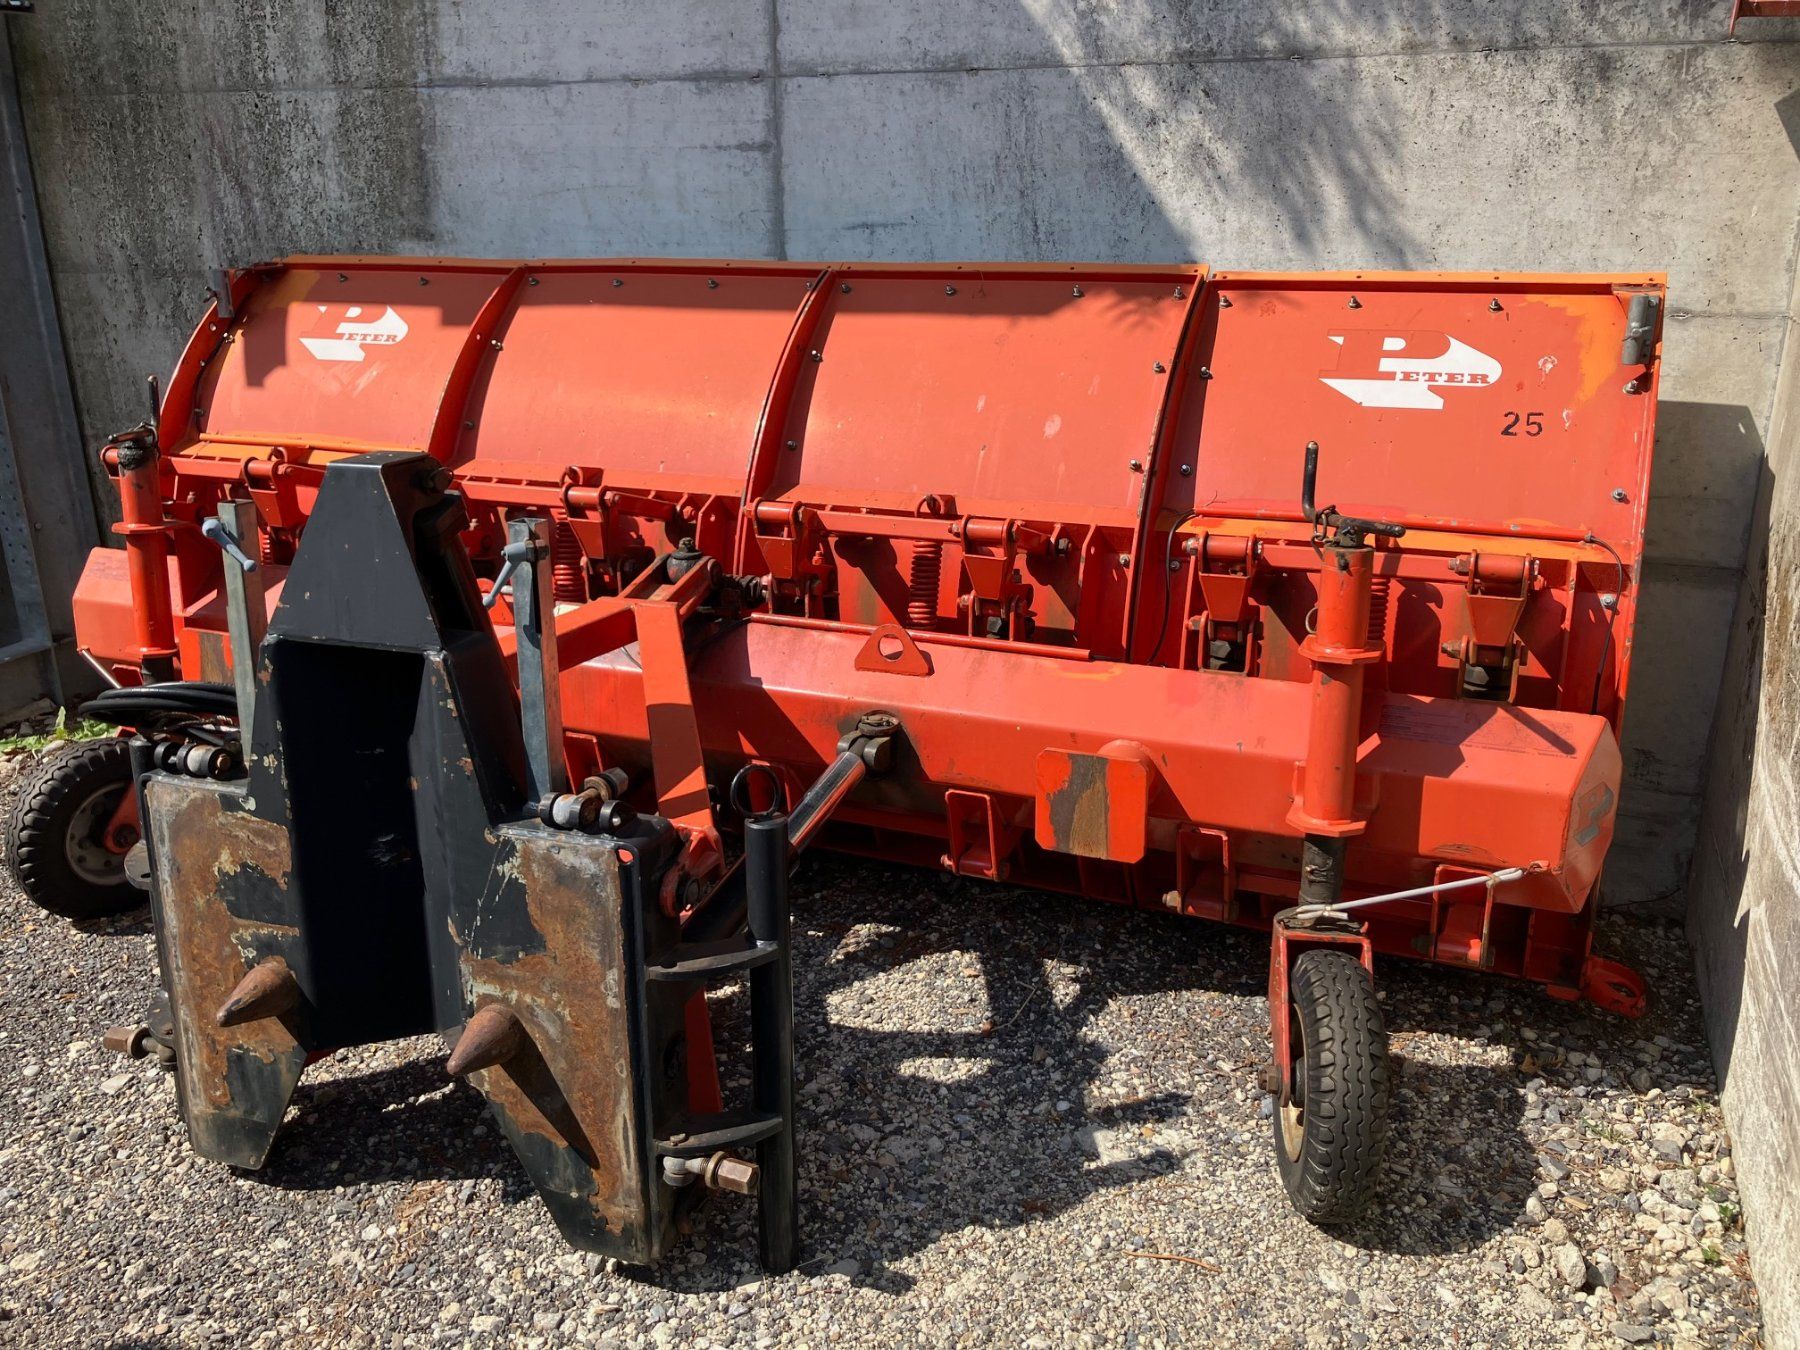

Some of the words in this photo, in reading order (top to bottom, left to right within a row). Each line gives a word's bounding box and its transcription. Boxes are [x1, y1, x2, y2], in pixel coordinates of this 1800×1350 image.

[300, 302, 398, 343] PETER
[1319, 328, 1491, 385] PETER
[1501, 411, 1544, 437] 25
